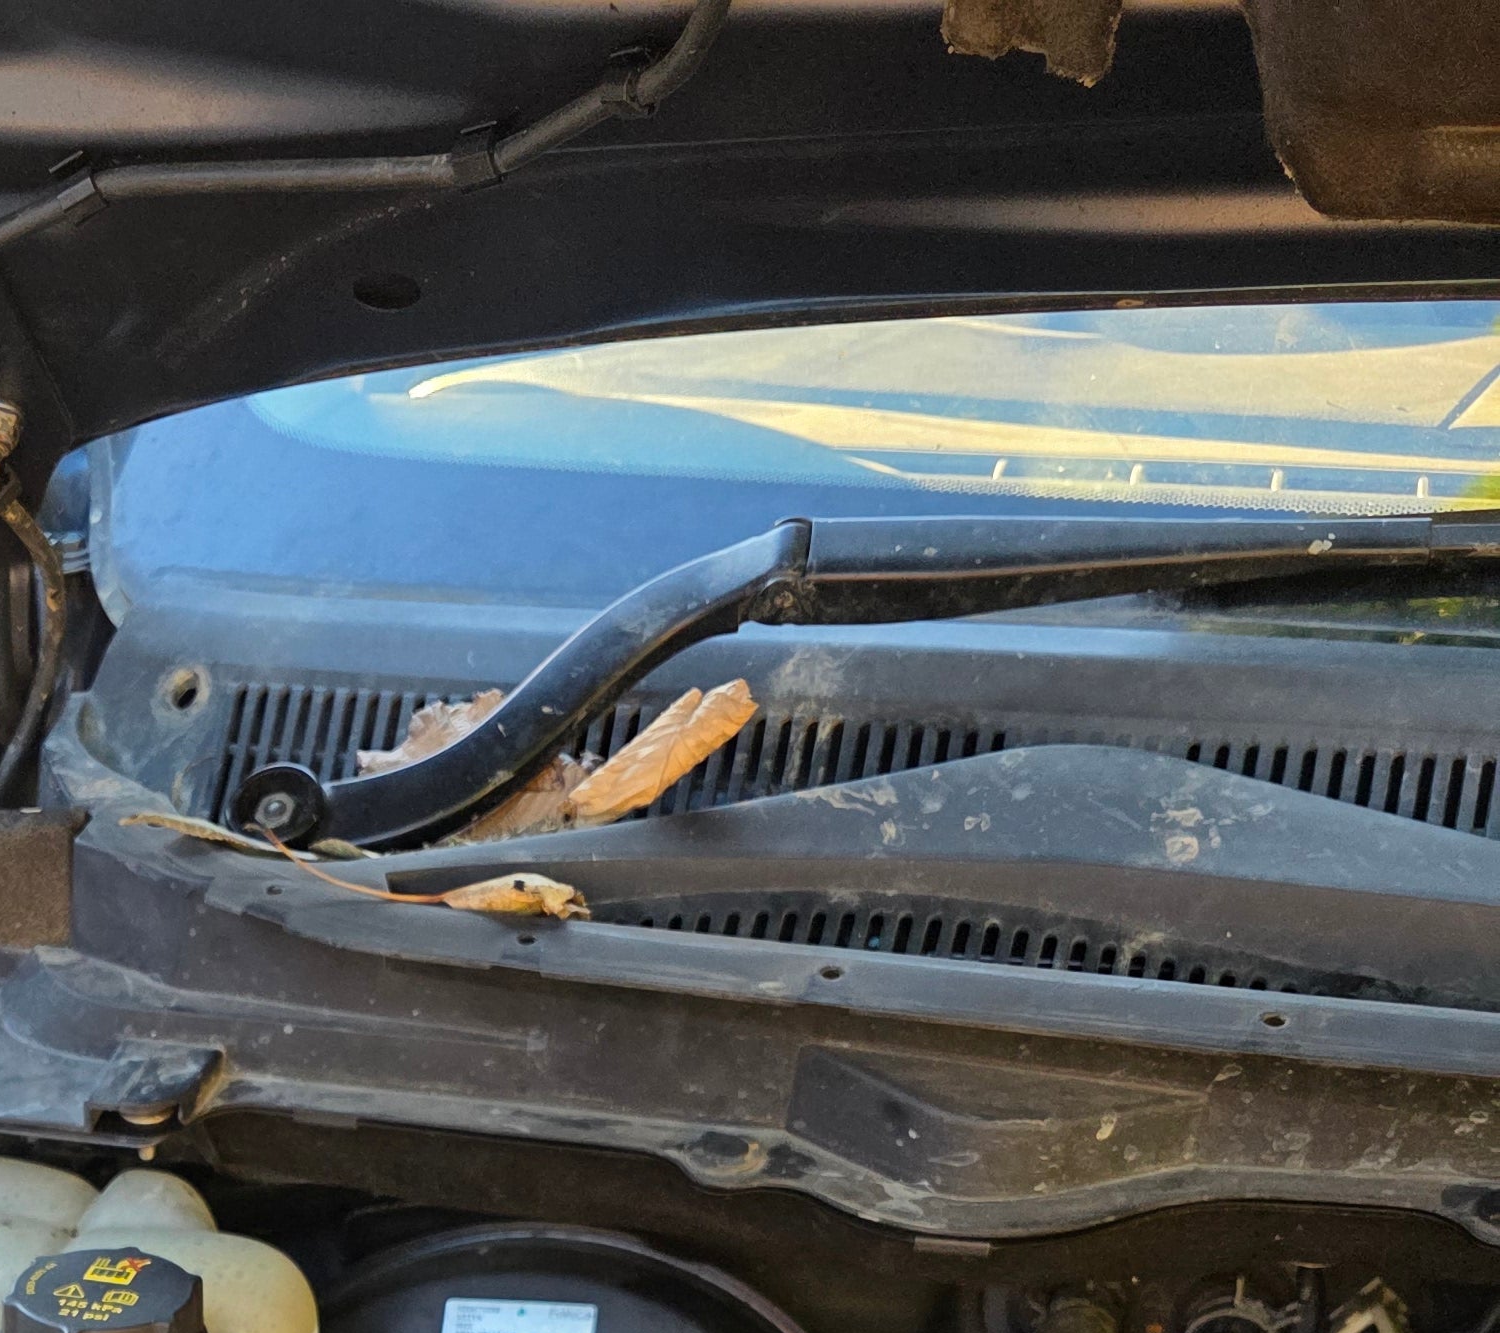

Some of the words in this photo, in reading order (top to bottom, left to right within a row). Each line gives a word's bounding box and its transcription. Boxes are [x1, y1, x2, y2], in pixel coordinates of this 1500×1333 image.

[58, 1298, 88, 1309] 145
[91, 1302, 123, 1314] kPa
[58, 1308, 79, 1317] 21
[82, 1312, 110, 1321] psi
